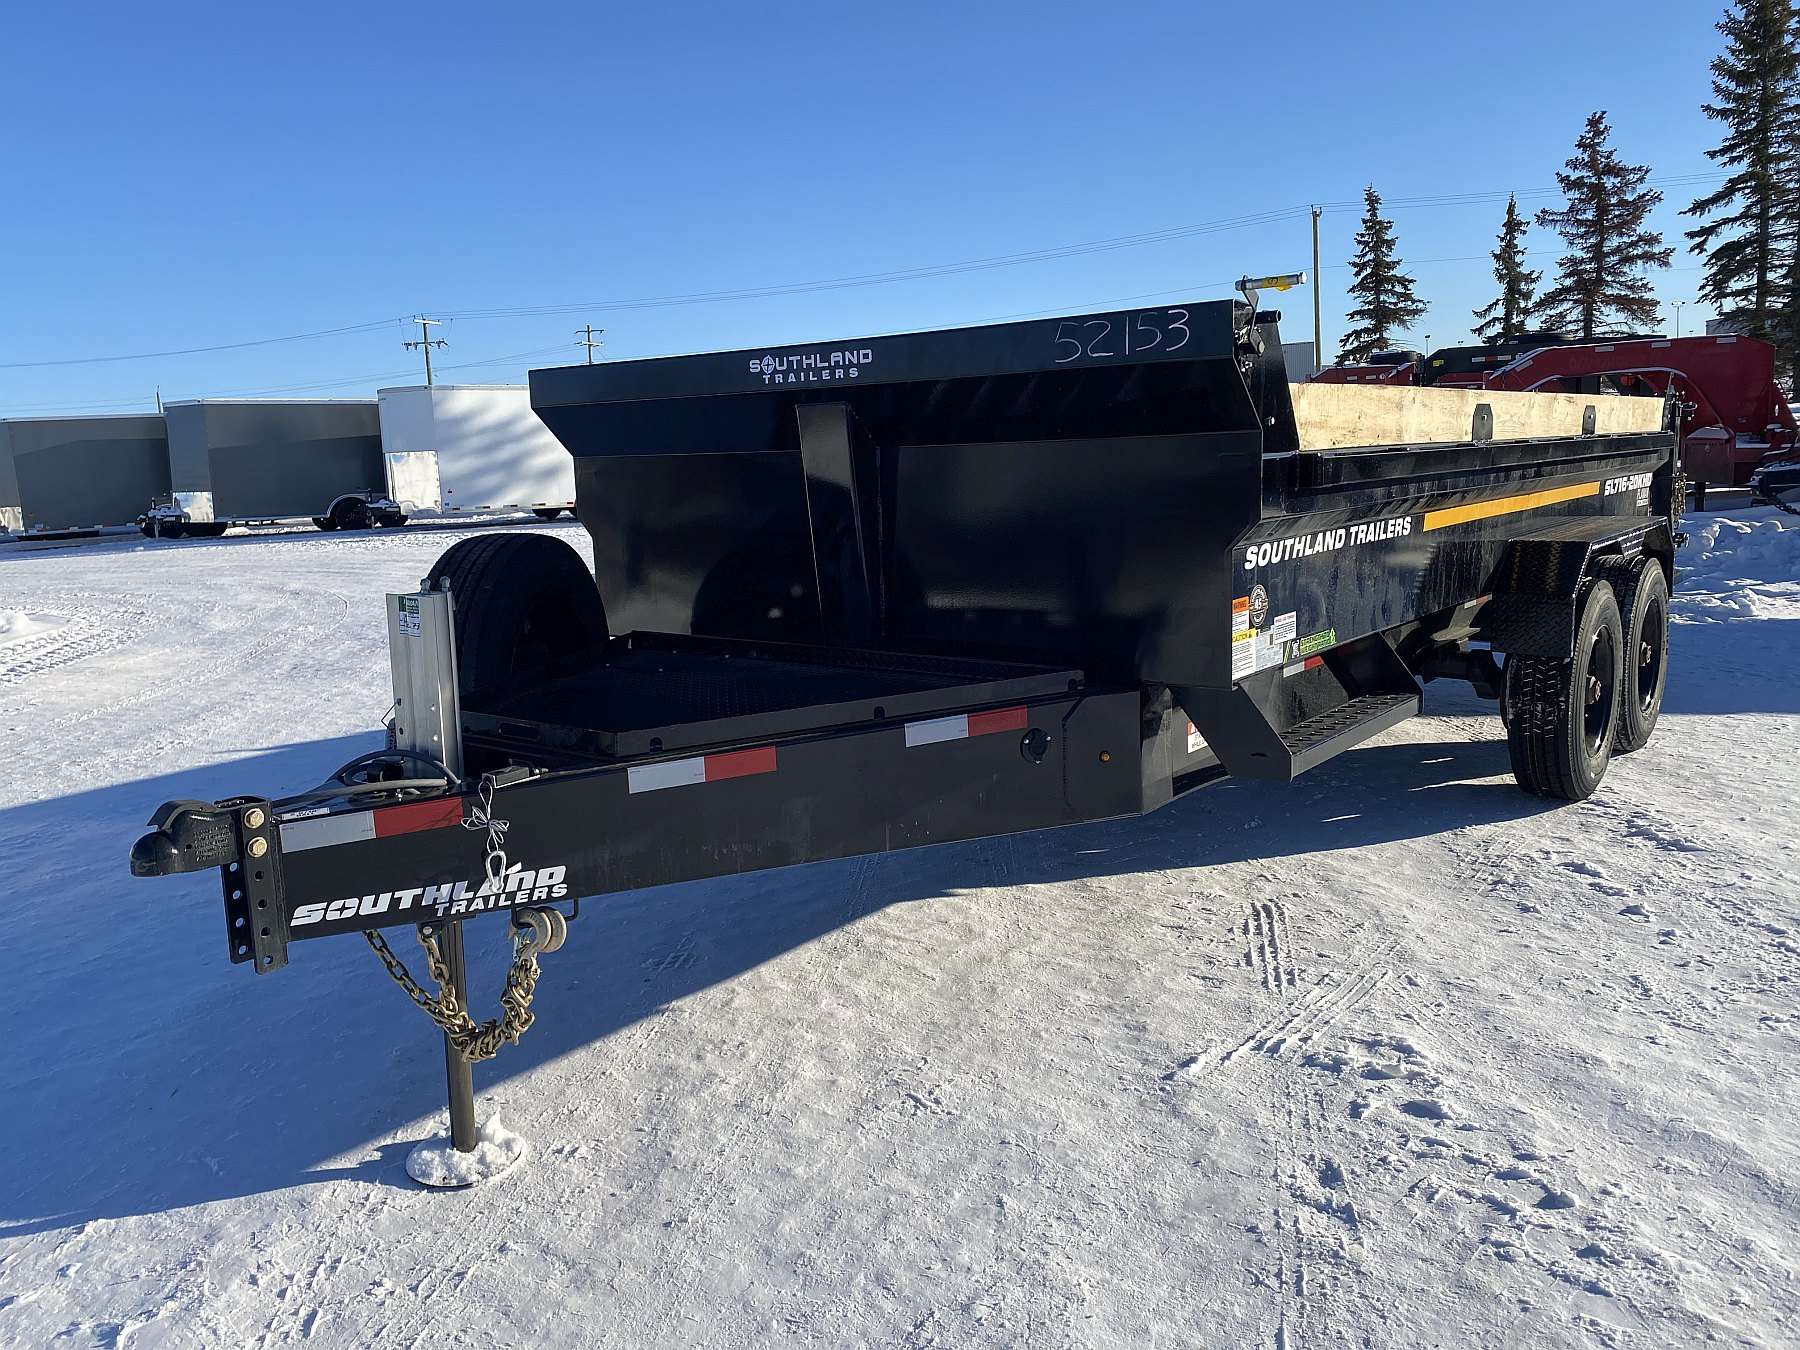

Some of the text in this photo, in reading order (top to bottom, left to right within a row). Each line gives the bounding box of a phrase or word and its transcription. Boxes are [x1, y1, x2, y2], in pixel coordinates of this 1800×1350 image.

[1054, 309, 1190, 362] 52153
[749, 349, 872, 374] SOUTHLAND
[763, 367, 858, 384] TRAILERS
[1244, 516, 1412, 570] SOUTHLAND TRAILERS
[290, 862, 567, 927] SOUTHLAND
[435, 883, 568, 917] TRAILERS
